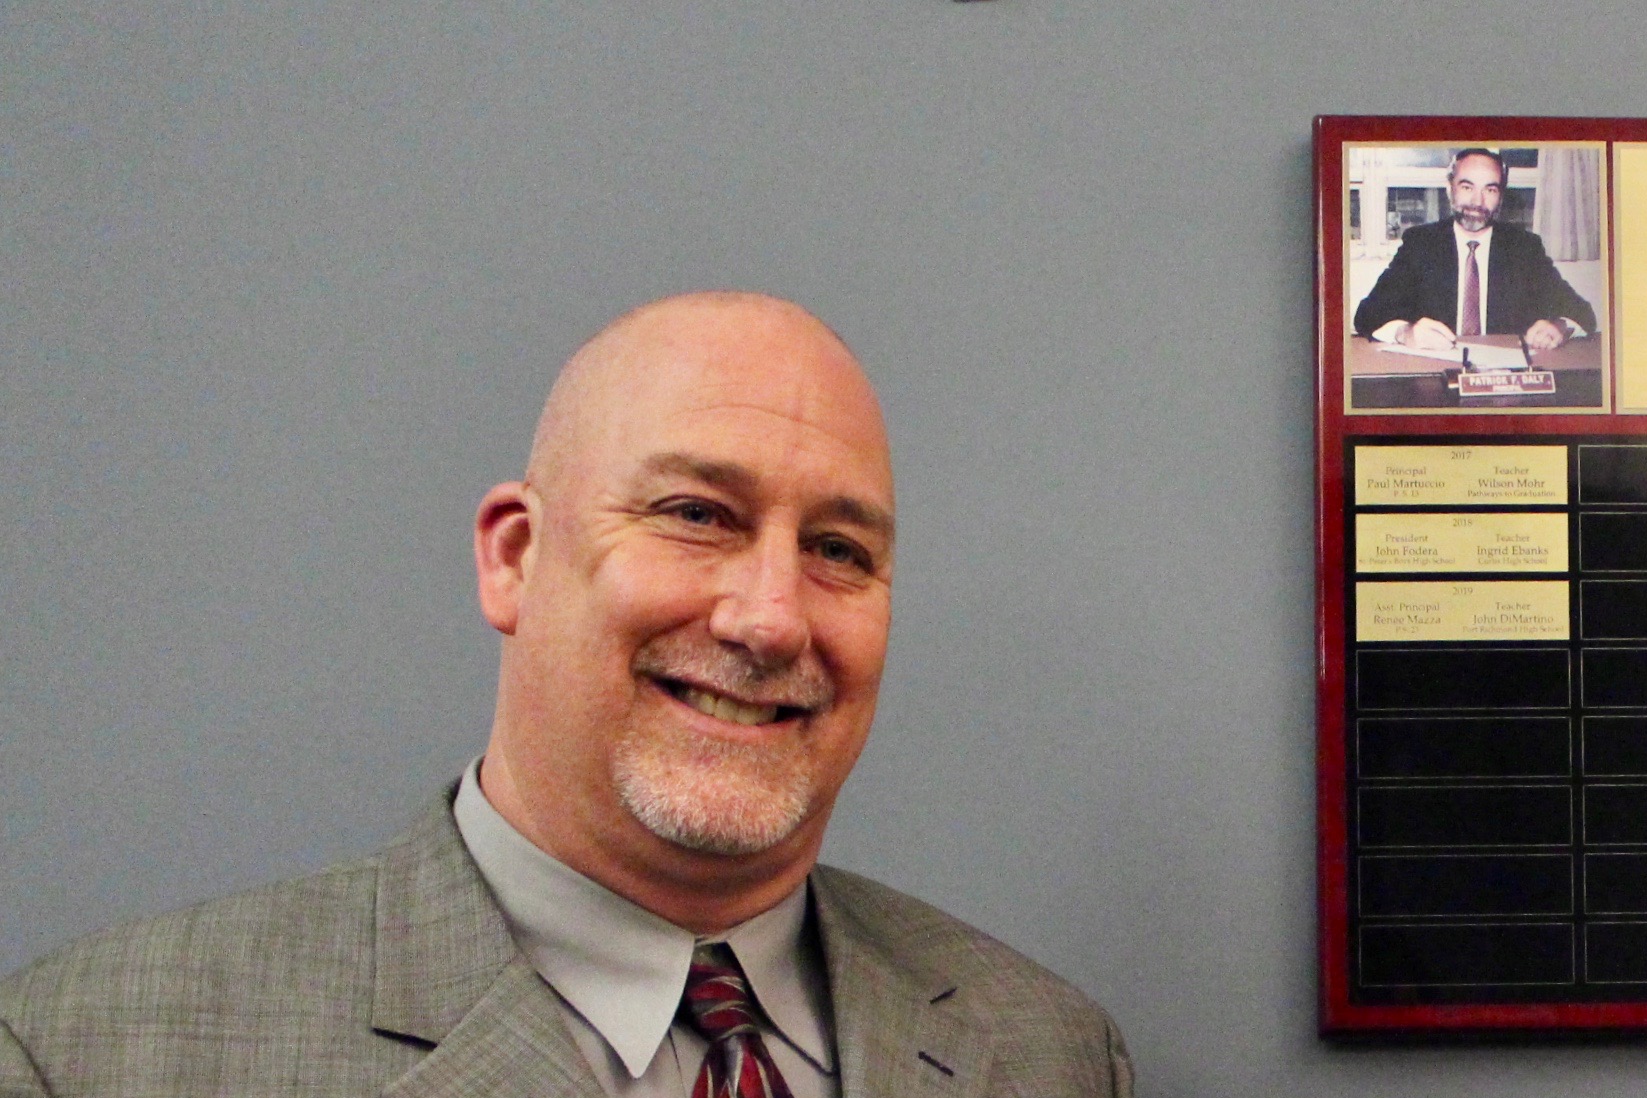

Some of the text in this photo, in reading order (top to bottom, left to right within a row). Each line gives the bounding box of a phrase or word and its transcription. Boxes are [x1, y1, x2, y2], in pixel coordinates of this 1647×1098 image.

[1386, 467, 1426, 476] Principal
[1368, 479, 1445, 488] Paul Martuccio
[1479, 479, 1545, 487] Wilson Mohr
[1386, 534, 1428, 542] President
[1496, 534, 1530, 542] Teacher
[1376, 546, 1438, 556] John Fodera
[1477, 546, 1548, 557] Ingrid Ebanks
[1496, 602, 1531, 610] Teacher
[1407, 615, 1441, 624] Mazza
[1474, 614, 1553, 624] John DiMartino
